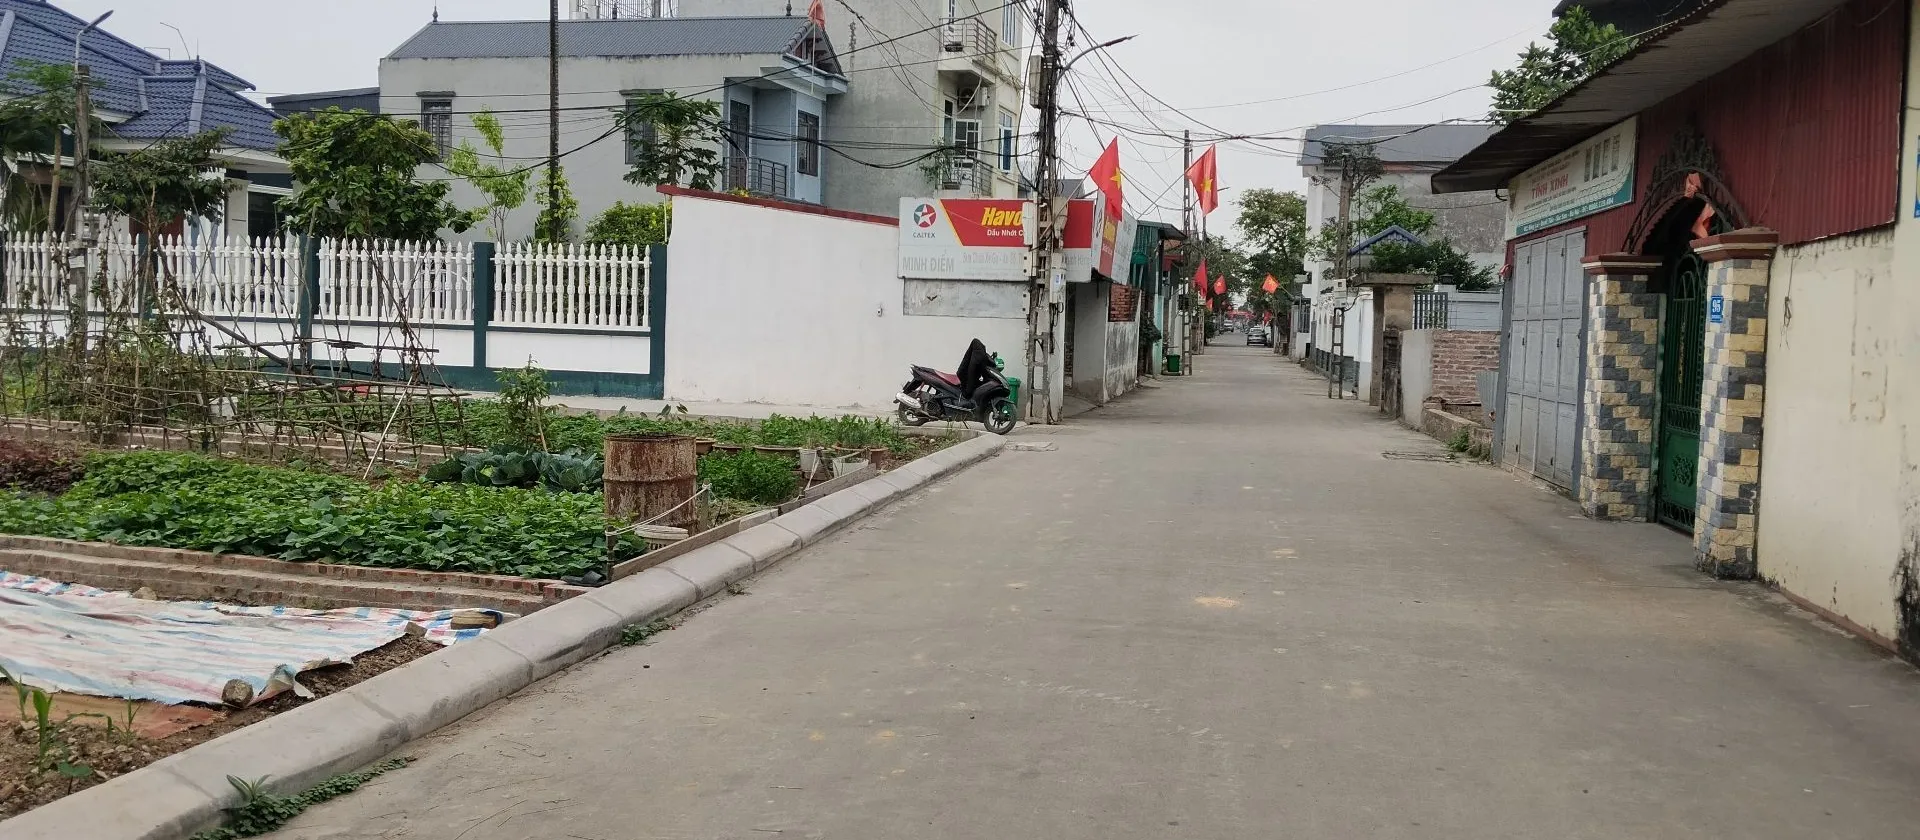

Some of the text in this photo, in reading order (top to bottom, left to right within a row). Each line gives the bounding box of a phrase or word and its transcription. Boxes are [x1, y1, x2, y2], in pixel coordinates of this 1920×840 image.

[981, 207, 1023, 226] Havo
[902, 256, 927, 271] MINH
[1712, 299, 1721, 313] 95
